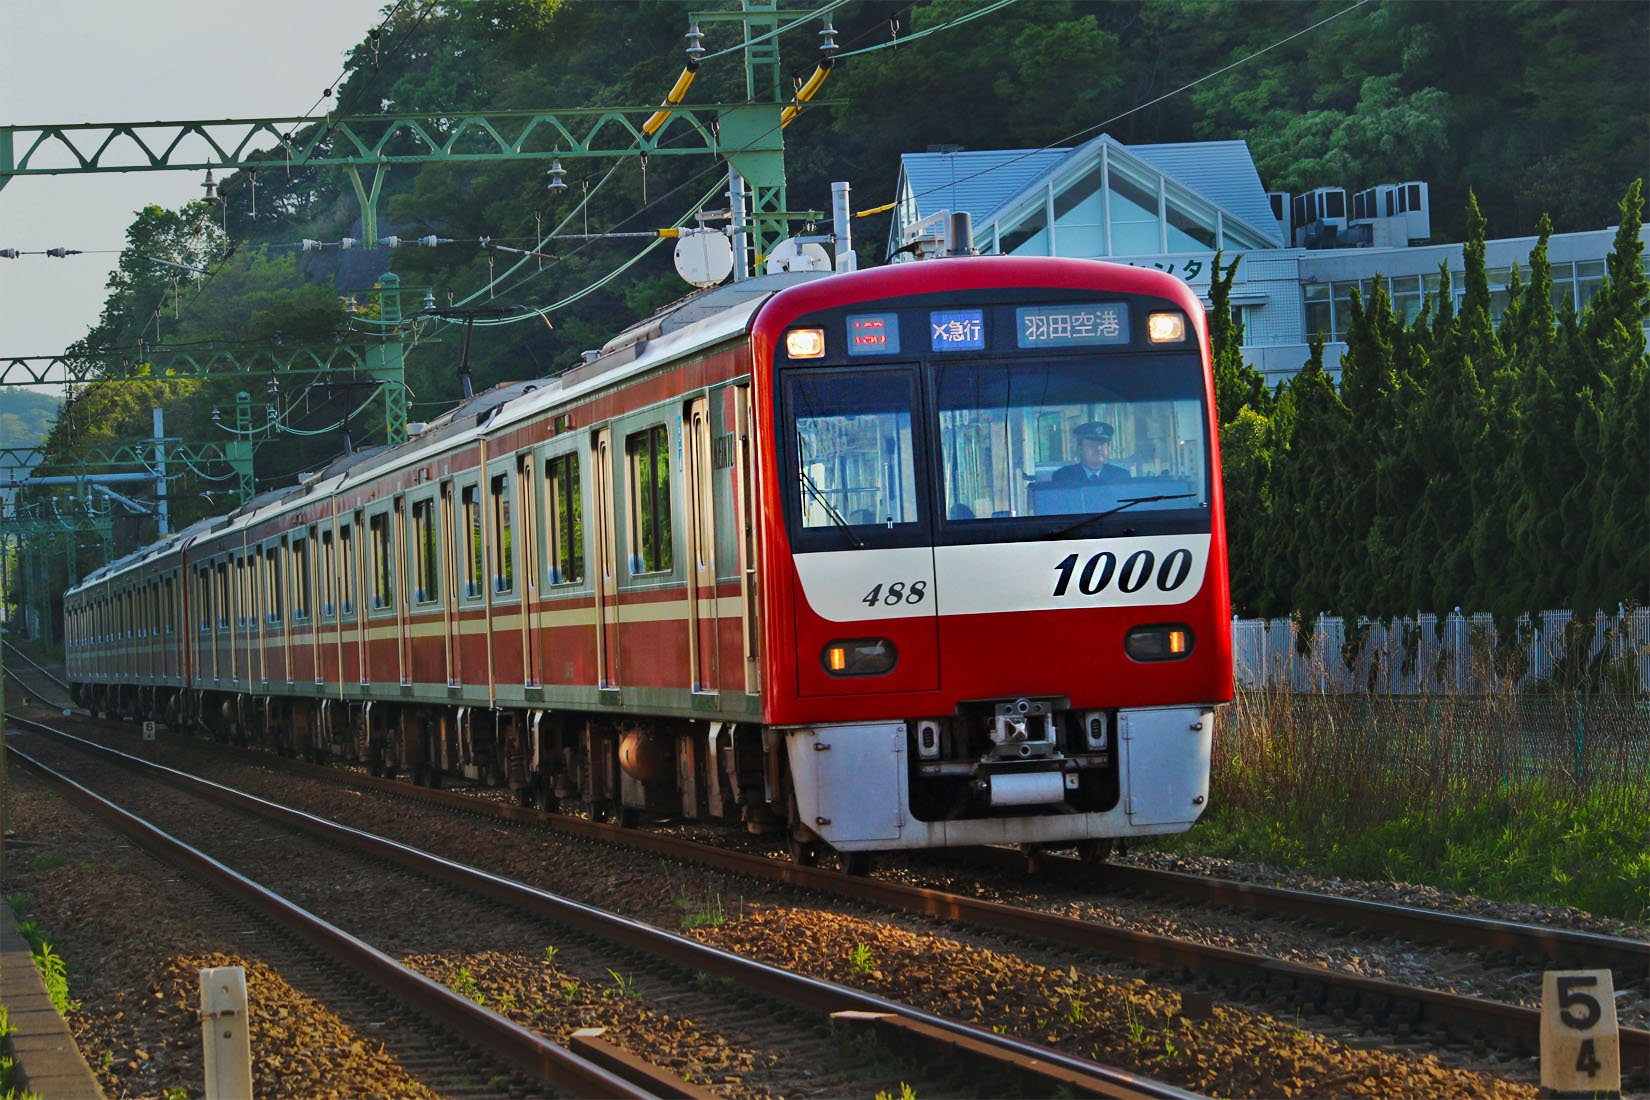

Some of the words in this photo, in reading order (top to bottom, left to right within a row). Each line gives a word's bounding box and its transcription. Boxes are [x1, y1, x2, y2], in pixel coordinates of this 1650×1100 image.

[1024, 310, 1120, 340] 羽田空港
[1052, 548, 1193, 597] 1000
[862, 580, 927, 607] 488
[1557, 976, 1602, 1031] 5
[1575, 1038, 1602, 1078] 4
